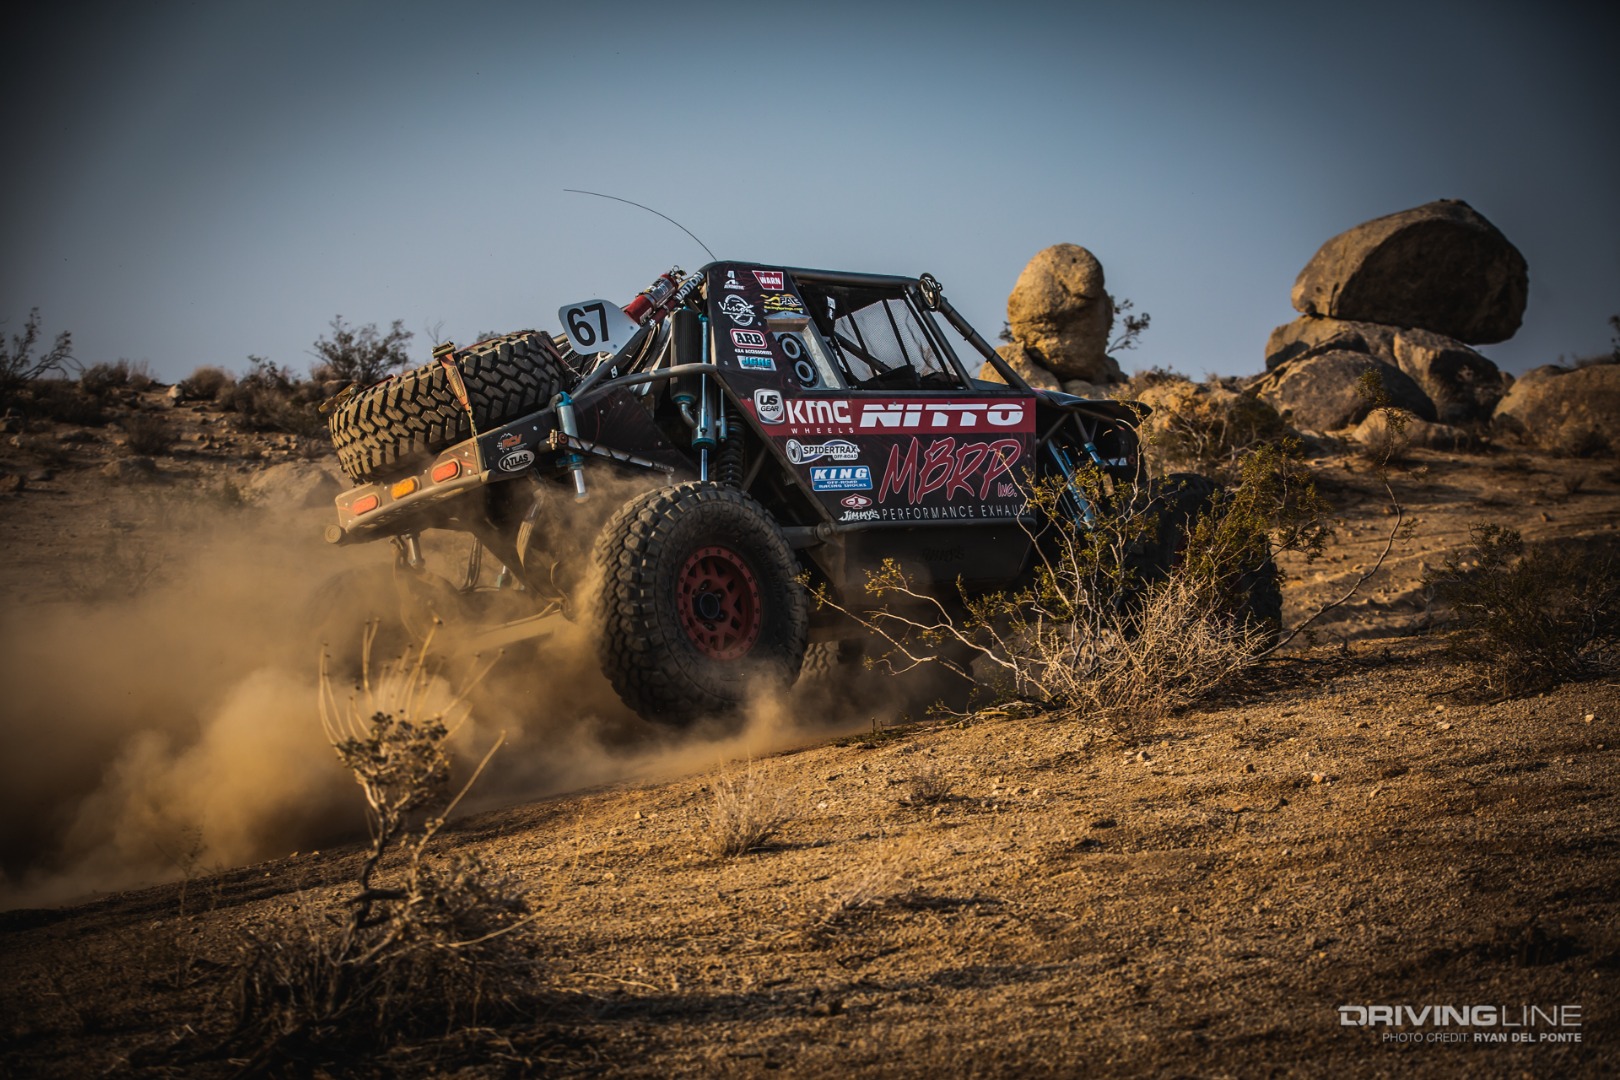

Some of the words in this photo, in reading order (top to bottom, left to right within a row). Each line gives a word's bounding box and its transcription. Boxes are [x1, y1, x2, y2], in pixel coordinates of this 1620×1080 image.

[759, 276, 782, 285] WARN
[567, 303, 610, 347] 67
[736, 332, 763, 345] ARB
[760, 395, 778, 405] US
[860, 403, 1024, 427] NITTO
[803, 445, 858, 455] SPIDERTRAX
[503, 453, 529, 469] ATLAS
[814, 468, 869, 479] KING
[878, 437, 1021, 504] MBRP
[882, 504, 974, 521] PERFORMANCE
